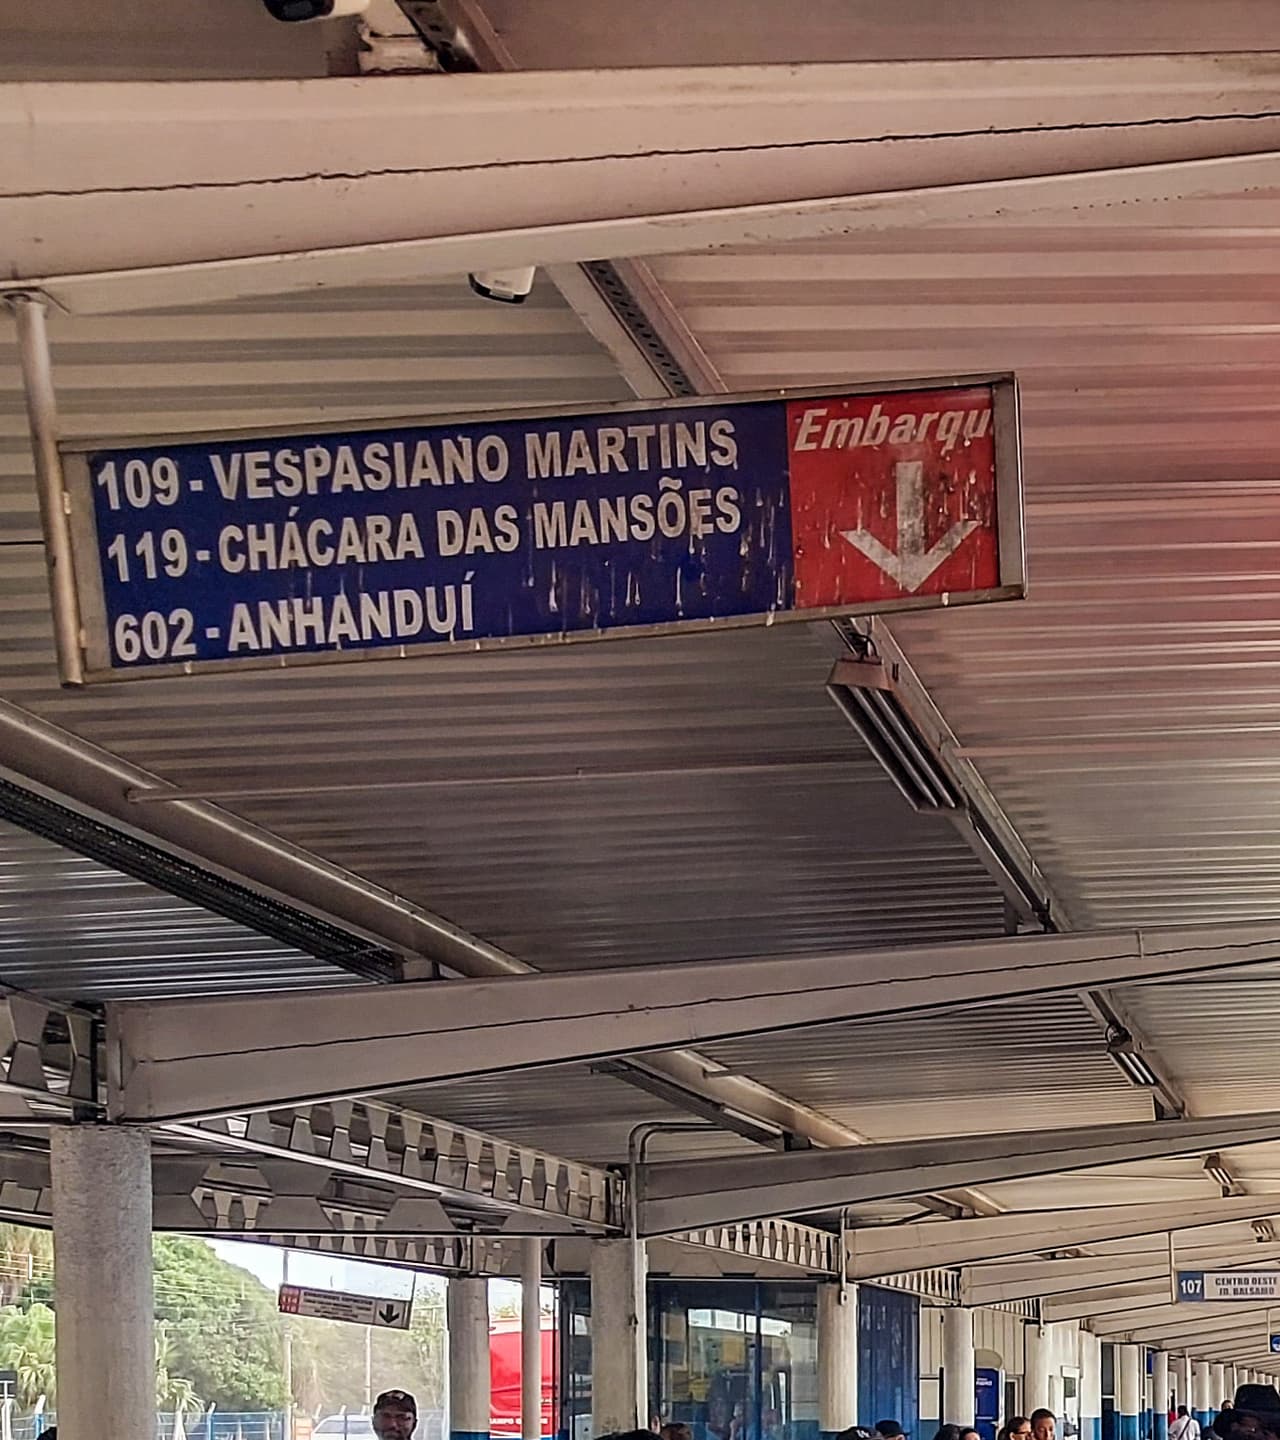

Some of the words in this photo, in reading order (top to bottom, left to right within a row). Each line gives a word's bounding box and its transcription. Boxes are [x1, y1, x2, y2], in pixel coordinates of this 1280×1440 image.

[209, 434, 510, 500] VESPASIANO
[525, 419, 738, 480] MARTINS
[794, 404, 991, 457] Embarqu
[218, 505, 425, 574] CHÁCARA
[437, 504, 520, 557] DAS
[533, 476, 742, 550] MANSÕES
[227, 570, 475, 652] ANHANDUÍ
[1180, 1279, 1202, 1294] 107
